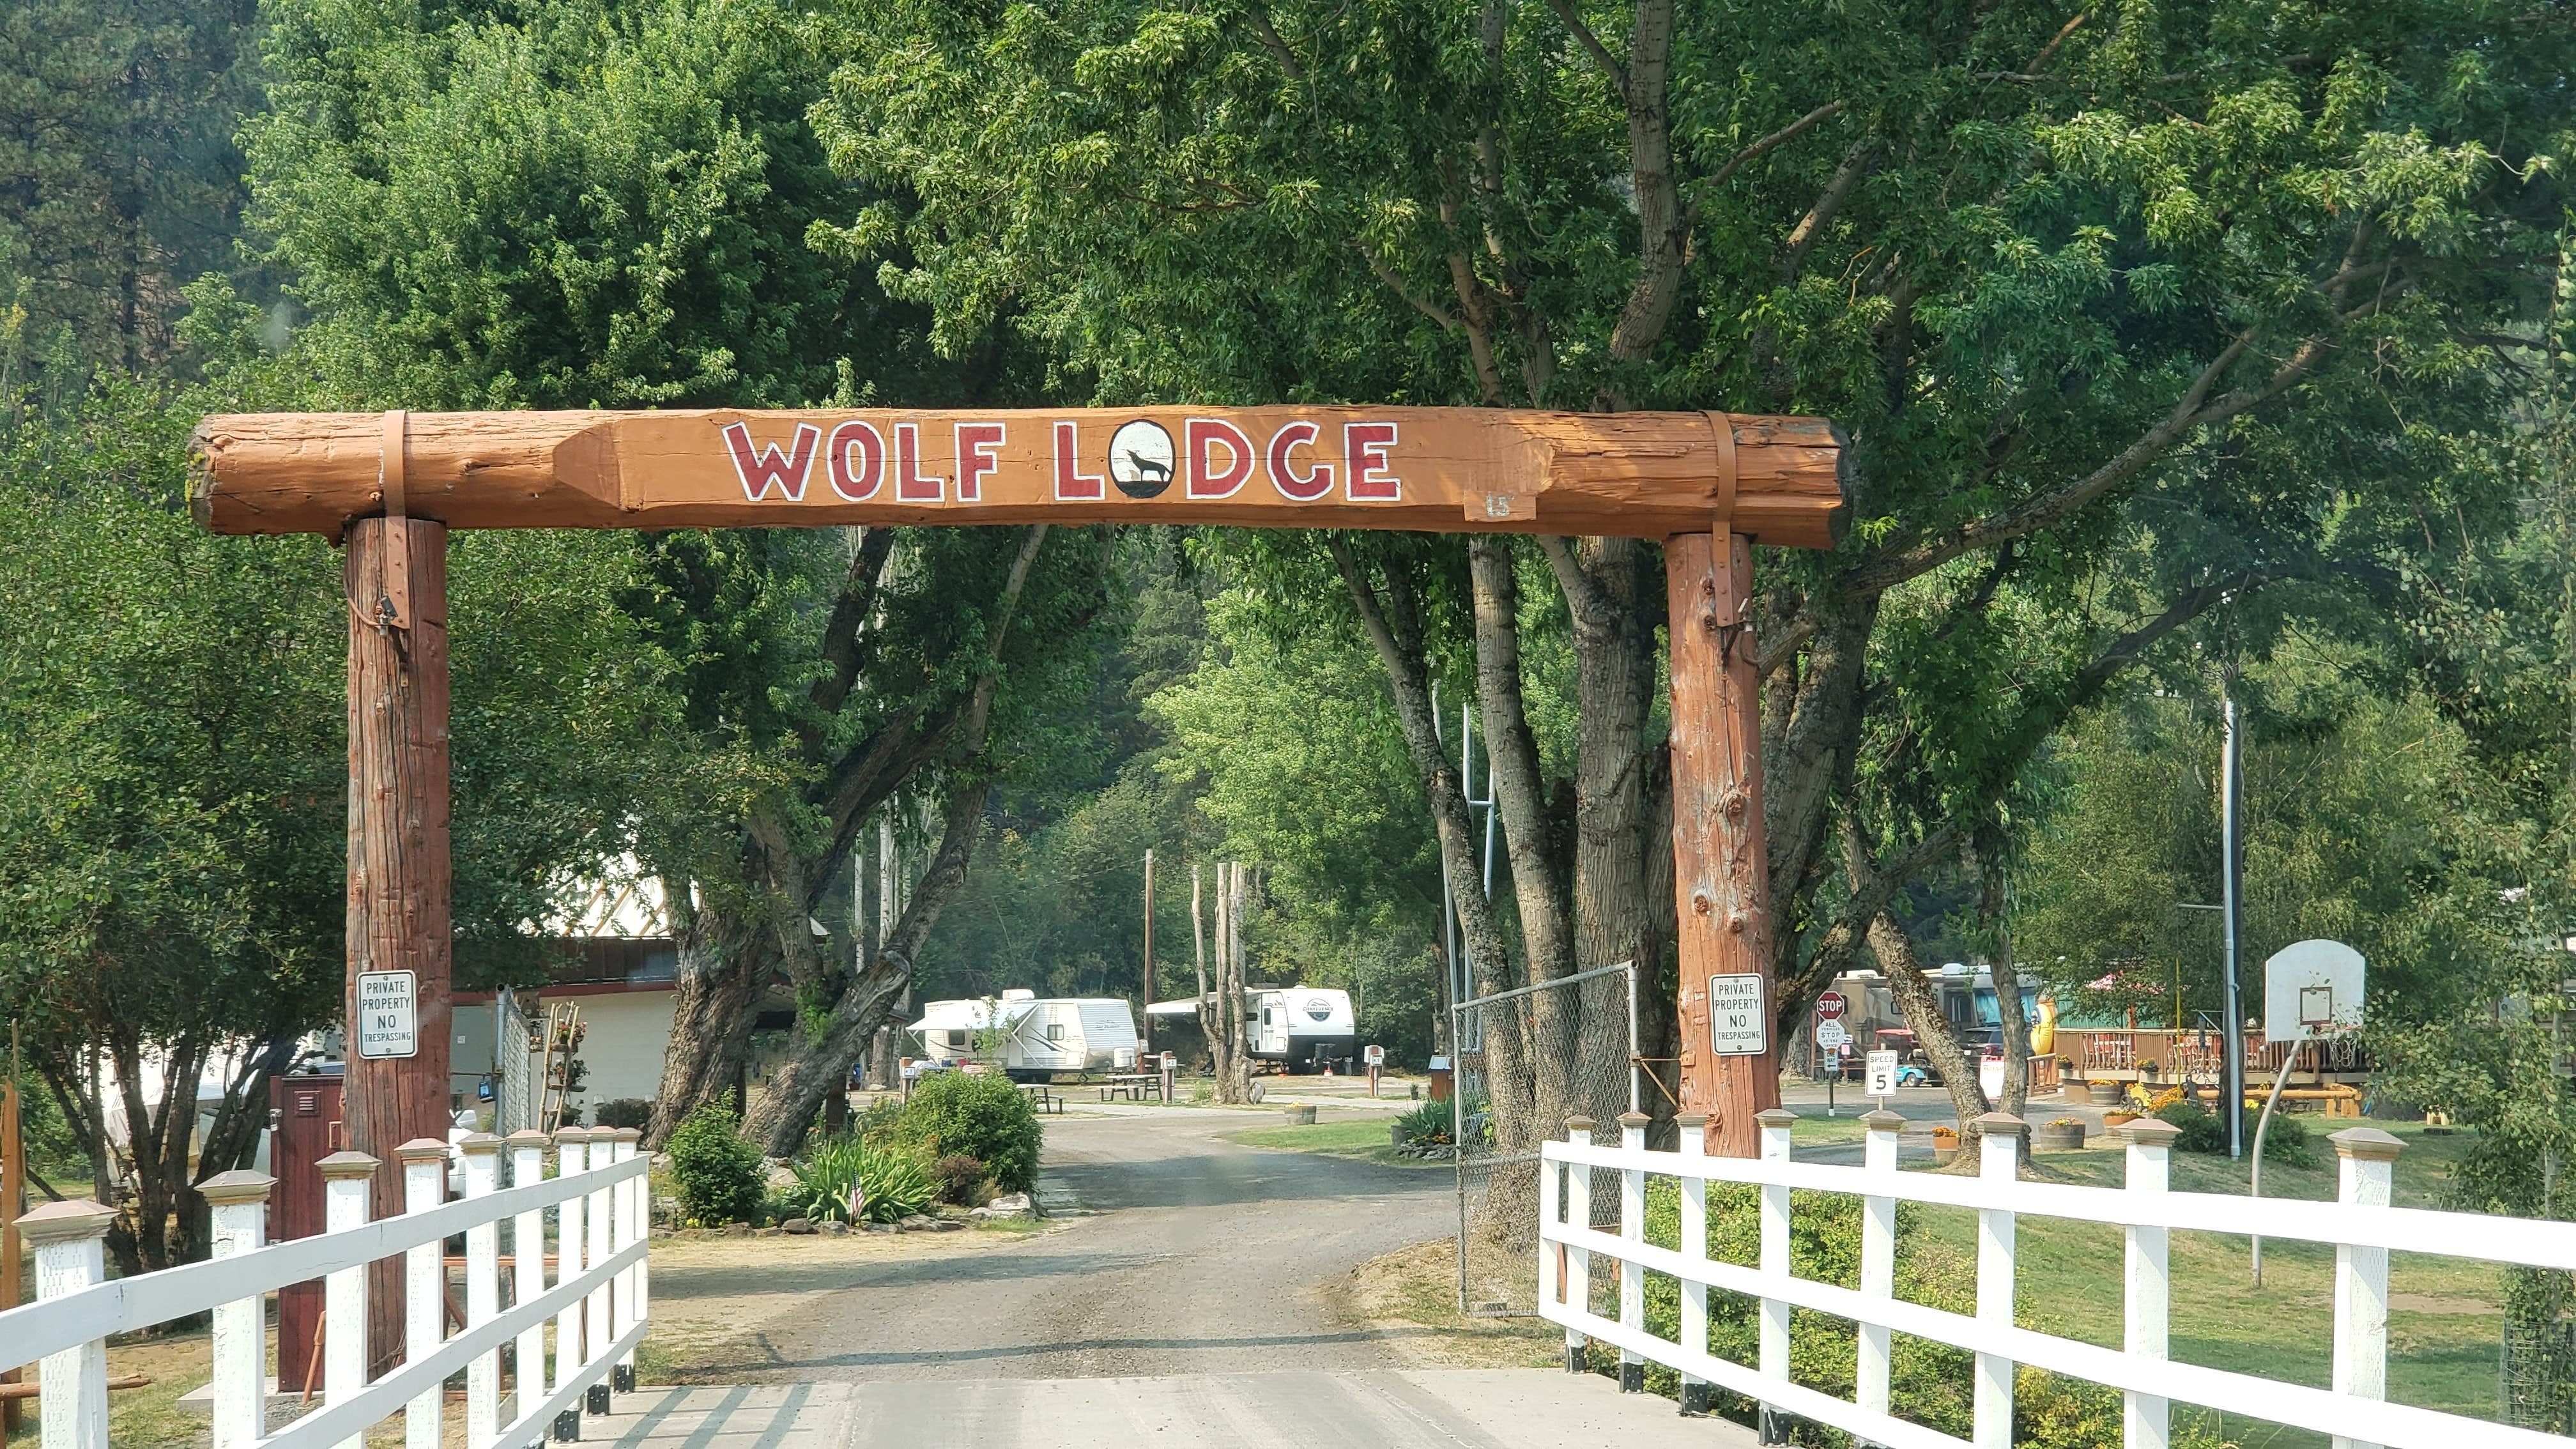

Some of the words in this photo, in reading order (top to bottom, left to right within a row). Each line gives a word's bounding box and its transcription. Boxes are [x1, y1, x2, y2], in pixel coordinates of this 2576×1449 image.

[721, 420, 1006, 502] WOLF
[366, 981, 406, 994] PRIVATE
[1719, 983, 1754, 995] PRIVATE
[362, 997, 410, 1011] PROPERTY
[1715, 999, 1759, 1011] PROPERTY
[1818, 1000, 1843, 1012] STOP
[378, 1015, 396, 1029] NO
[1729, 1015, 1747, 1027] NO
[364, 1032, 411, 1043] TRESPASSING
[1717, 1031, 1760, 1040] TRESPASSING
[1876, 1074, 1887, 1090] 5
